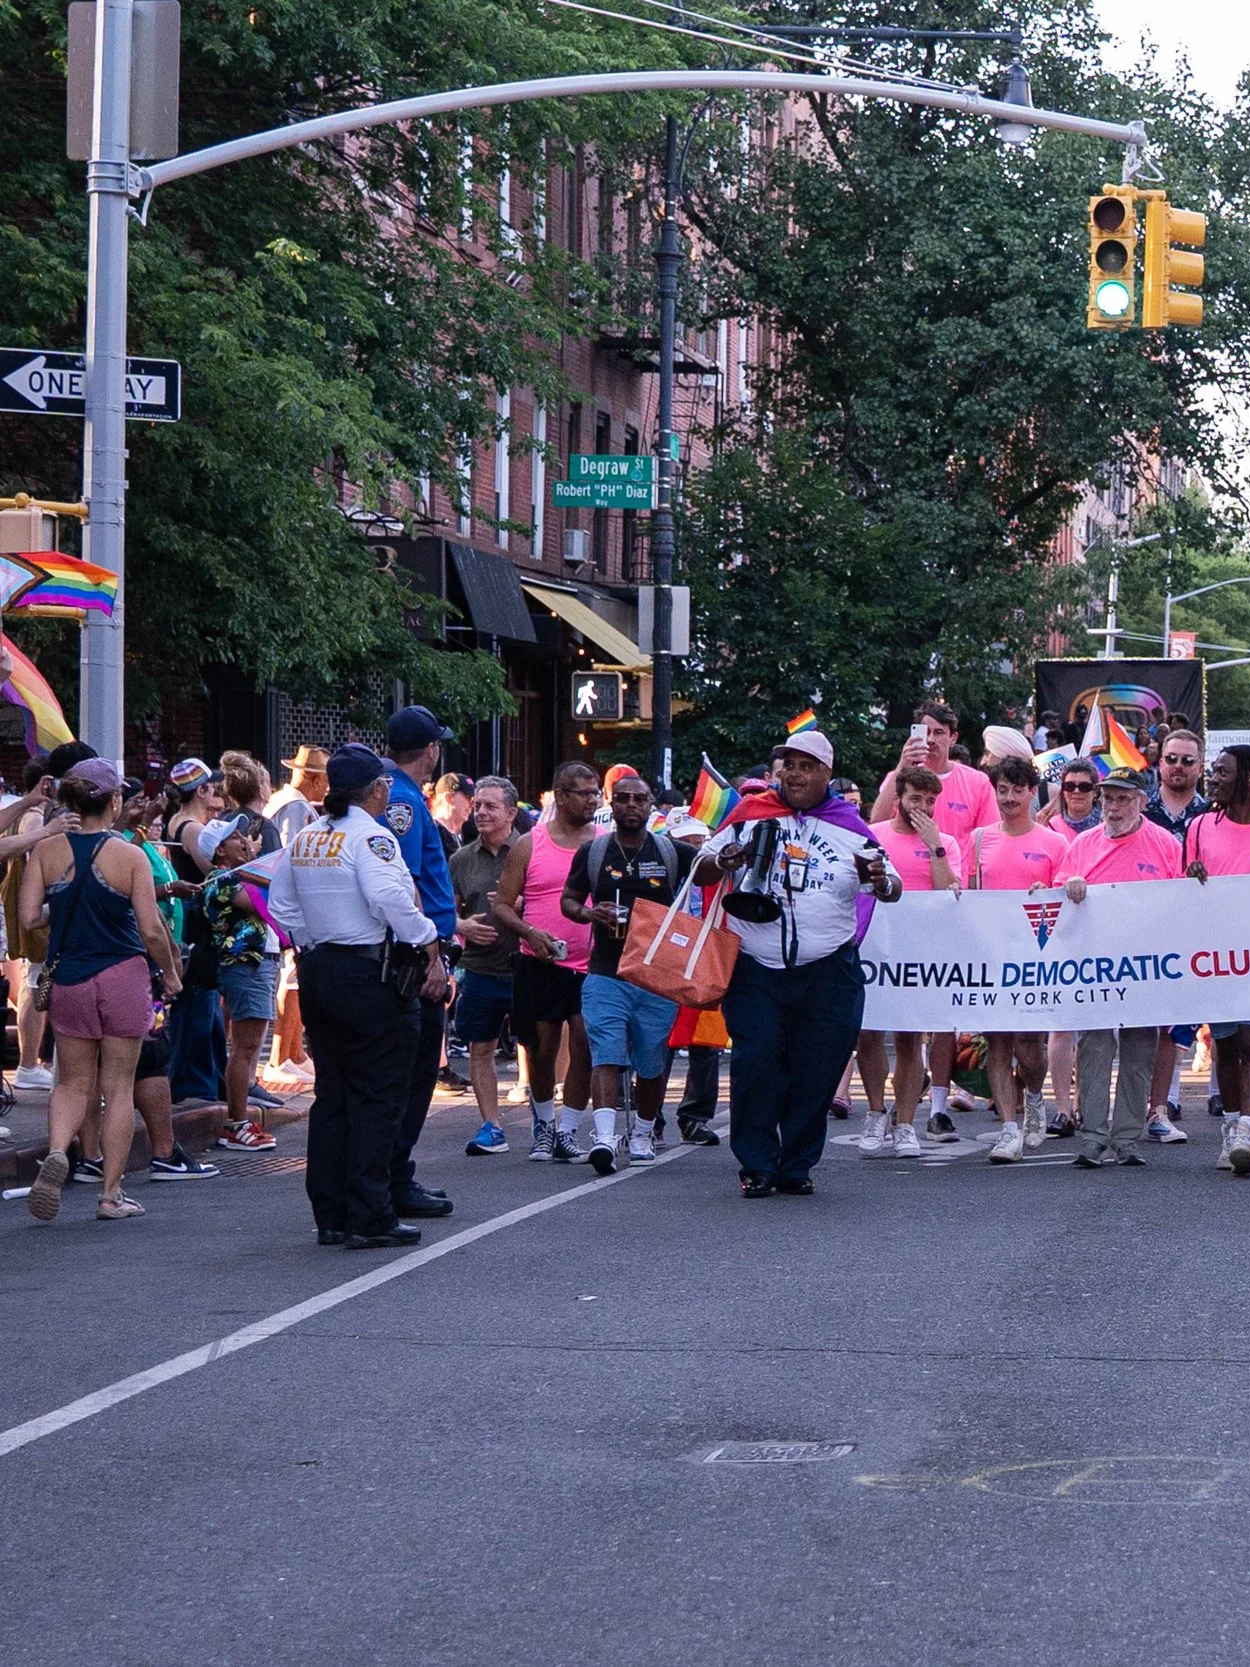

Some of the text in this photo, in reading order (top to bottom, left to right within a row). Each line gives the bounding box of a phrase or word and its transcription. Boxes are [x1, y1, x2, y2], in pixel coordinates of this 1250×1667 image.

[28, 370, 153, 400] ONE AY
[580, 456, 645, 480] Degraw St
[556, 483, 648, 499] Robert "PH" Diaz
[291, 829, 347, 857] NYPD
[808, 832, 840, 865] WEEK
[860, 960, 994, 987] ONEWALL
[1002, 952, 1184, 988] DEMOCRATIC
[951, 988, 1128, 1006] NEW YORK CITY
